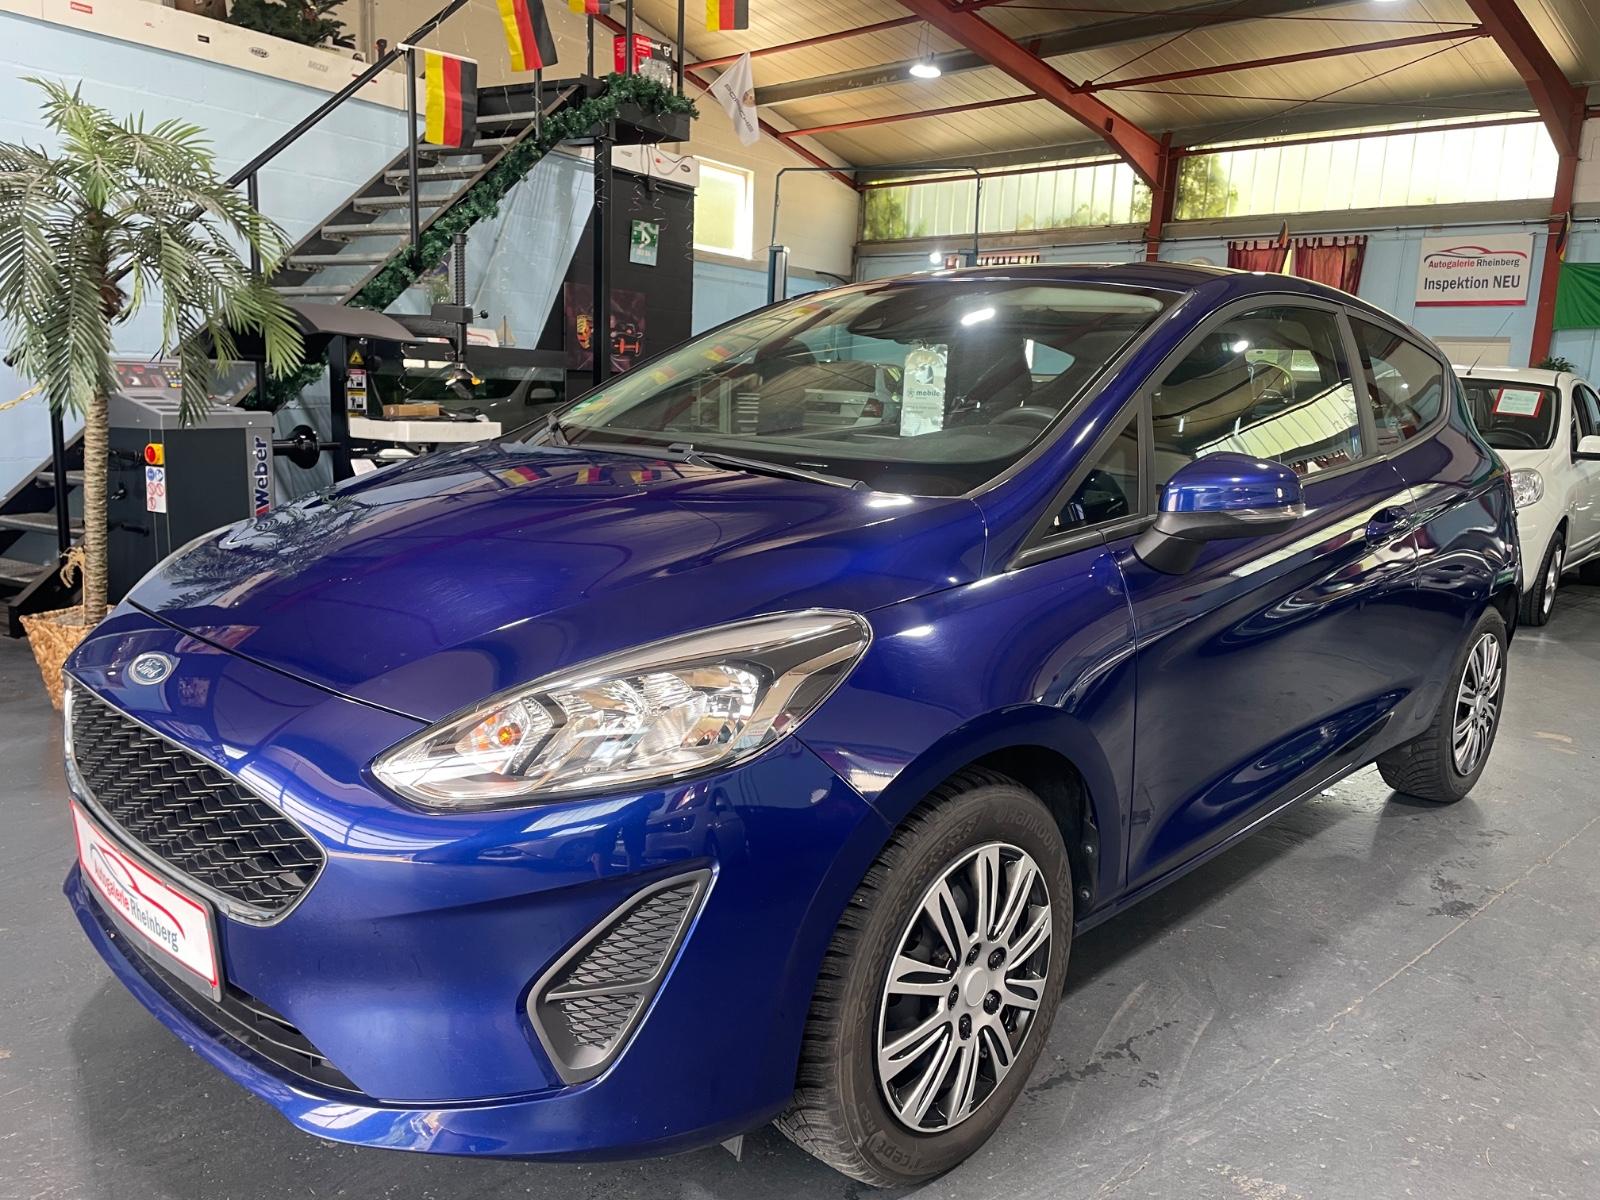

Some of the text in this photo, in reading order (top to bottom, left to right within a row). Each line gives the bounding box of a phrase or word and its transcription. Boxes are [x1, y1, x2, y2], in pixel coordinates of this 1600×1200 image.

[1428, 258, 1520, 269] Autogalerie Rheinberg
[1424, 275, 1520, 292] Inspektion NEU
[136, 658, 164, 678] Ford
[129, 898, 179, 953] Rheinberg
